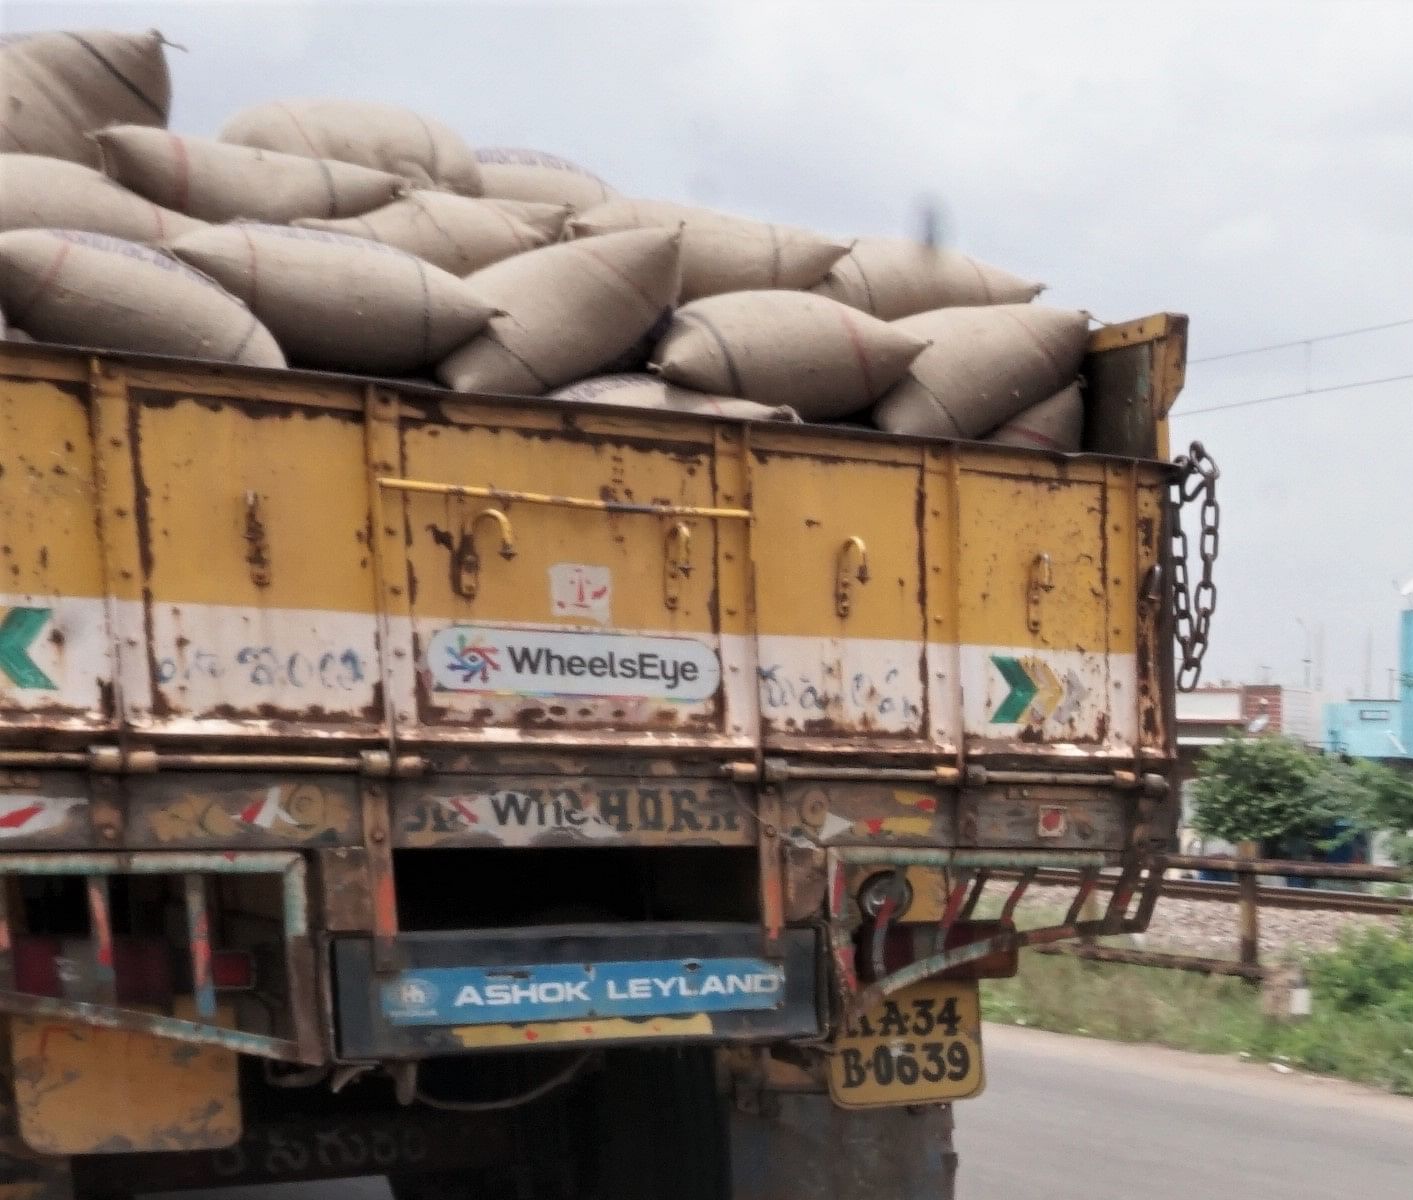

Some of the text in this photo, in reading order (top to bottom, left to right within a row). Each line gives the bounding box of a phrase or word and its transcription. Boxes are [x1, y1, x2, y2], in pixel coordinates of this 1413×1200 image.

[508, 645, 699, 687] WheelsEye
[453, 972, 781, 1007] ASHOK LEYLAND
